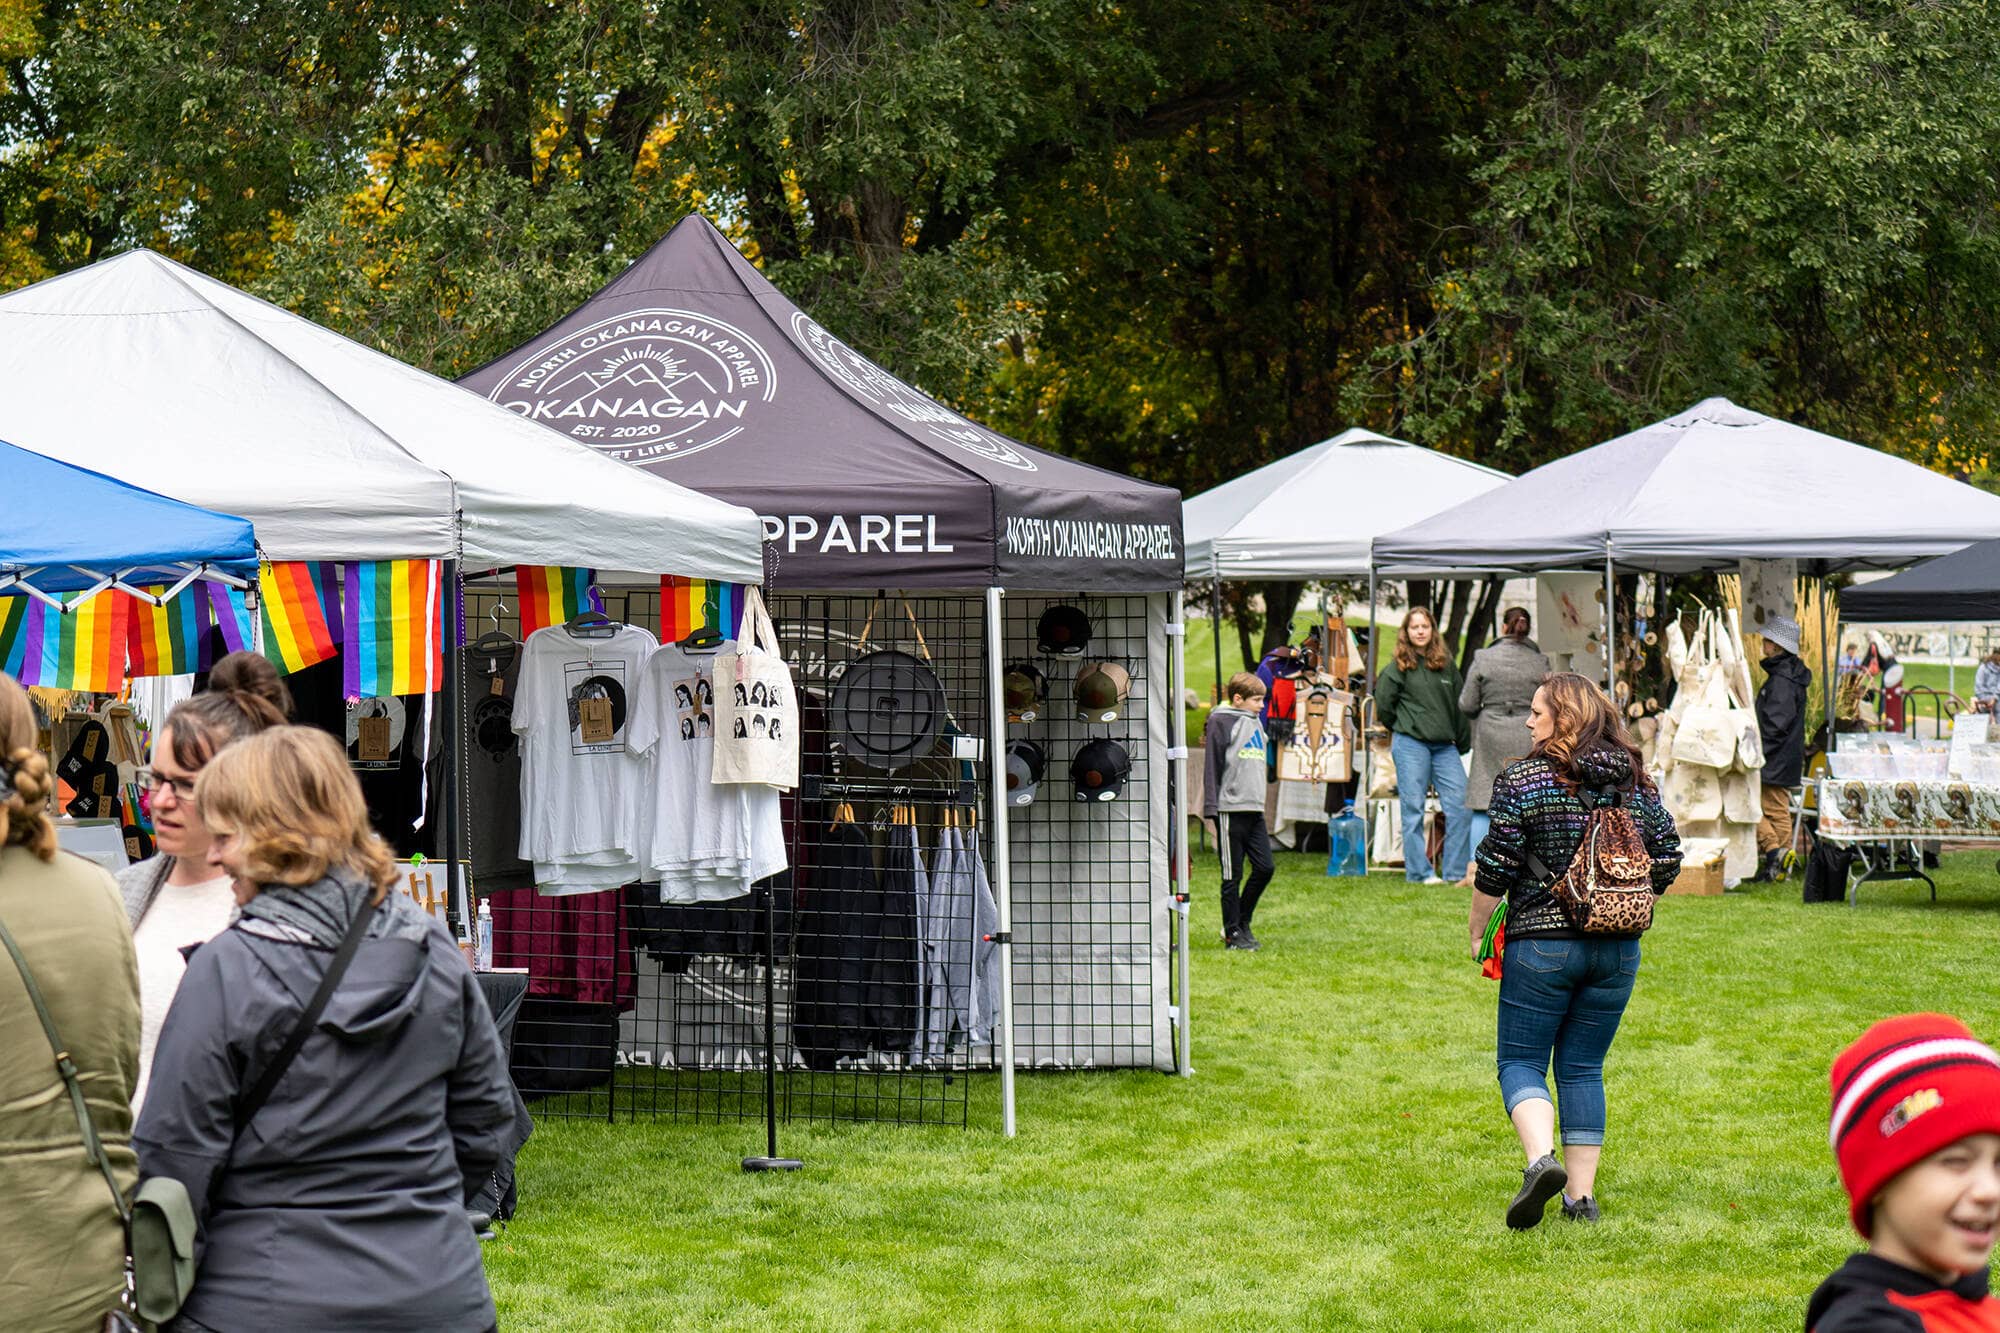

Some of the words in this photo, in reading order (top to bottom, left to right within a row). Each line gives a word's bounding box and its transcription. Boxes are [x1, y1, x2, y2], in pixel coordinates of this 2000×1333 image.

[516, 348, 577, 389] NORTH
[580, 319, 708, 349] OKANAGAN
[711, 338, 760, 389] APPAREL
[503, 399, 748, 419] OKANAGAN
[570, 423, 604, 437] EST.
[610, 424, 661, 438] 2020
[637, 441, 679, 457] LIFE
[1006, 516, 1051, 557] NORTH
[1053, 519, 1122, 559] OKANAGAN
[1123, 524, 1177, 560] APPAREL
